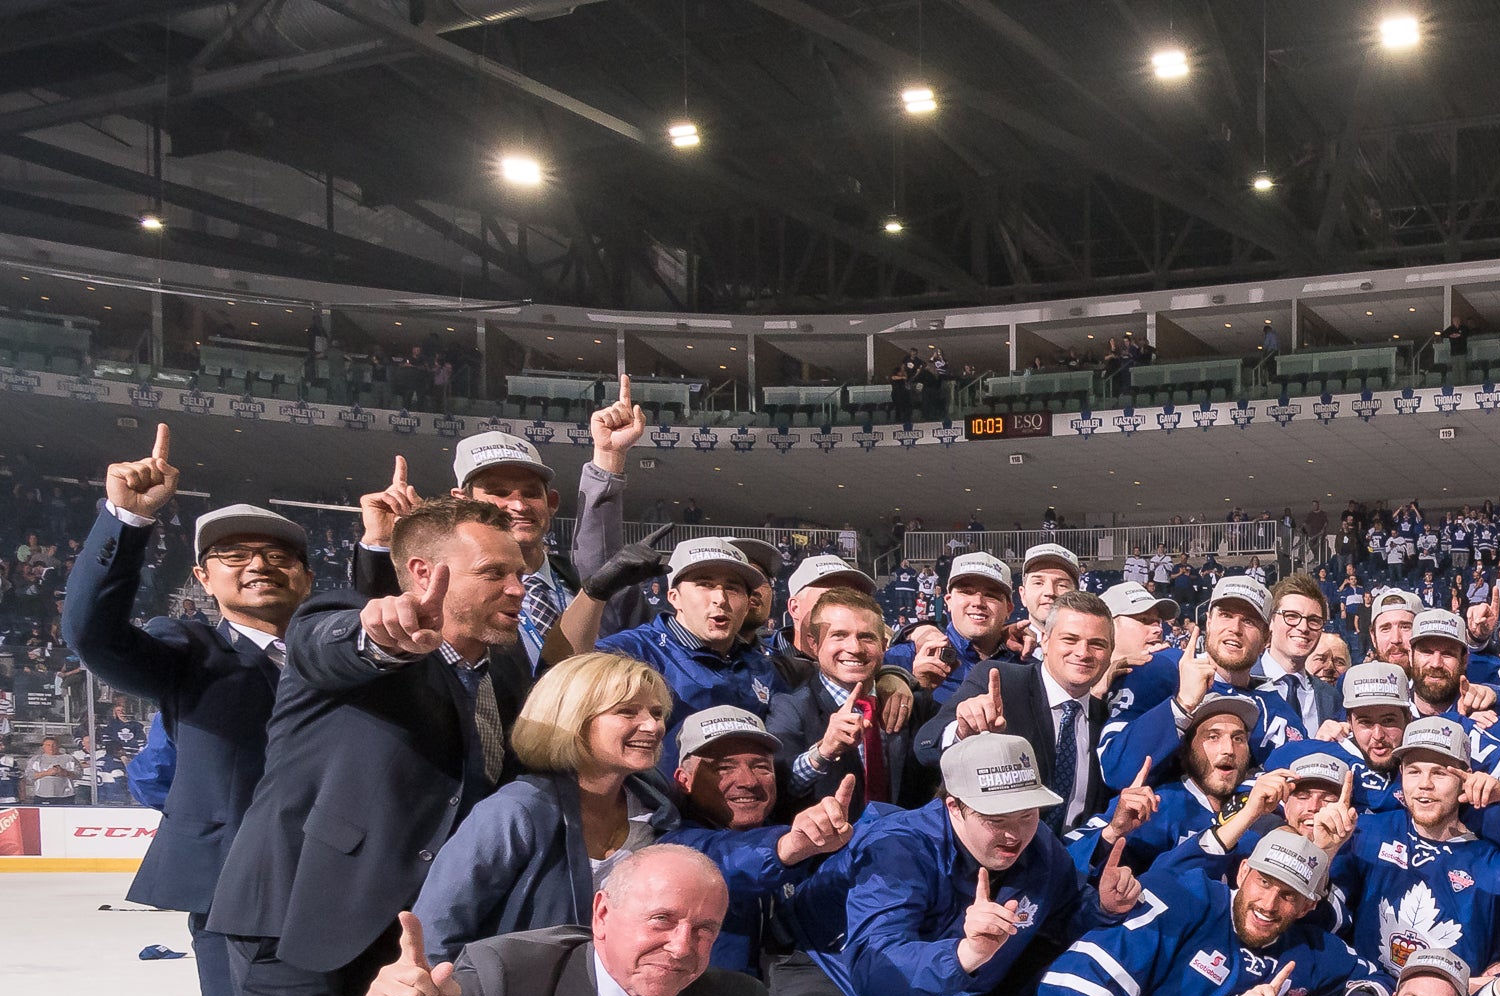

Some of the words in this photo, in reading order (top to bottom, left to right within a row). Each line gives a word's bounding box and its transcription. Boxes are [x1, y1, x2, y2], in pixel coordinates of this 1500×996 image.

[1353, 400, 1381, 410] GRAHAM
[1397, 398, 1419, 408] DOWIE
[1435, 395, 1461, 405] THOMAS
[282, 406, 324, 419] CARLETON
[1231, 409, 1255, 418] PERLINI
[1314, 403, 1339, 414] HIGGINS
[391, 415, 417, 427] SMITH
[1113, 416, 1145, 426] KASZYCKI
[1159, 414, 1179, 424] GAVIN
[1194, 411, 1217, 421] HARRIS
[972, 417, 1003, 434] 10:03
[1014, 414, 1043, 430] ESQ
[1072, 419, 1100, 429] STAMLER
[527, 426, 552, 437] BYERS
[652, 432, 679, 441] GLENNIE
[934, 429, 962, 437] ANDERSON
[1441, 429, 1452, 437] 119
[694, 433, 715, 442] EVANS
[769, 434, 799, 442] FERGUSON
[1354, 684, 1398, 694] CHAMPIONS
[1260, 716, 1288, 749] A
[1407, 733, 1451, 746] CHAMPIONS
[991, 765, 1013, 773] CALDER
[978, 769, 1036, 787] CHAMPIONS
[73, 826, 158, 838] CCM
[1280, 846, 1297, 859] CALDER
[1266, 848, 1313, 880] CHAMPIONS
[1193, 958, 1223, 983] Scotiabank
